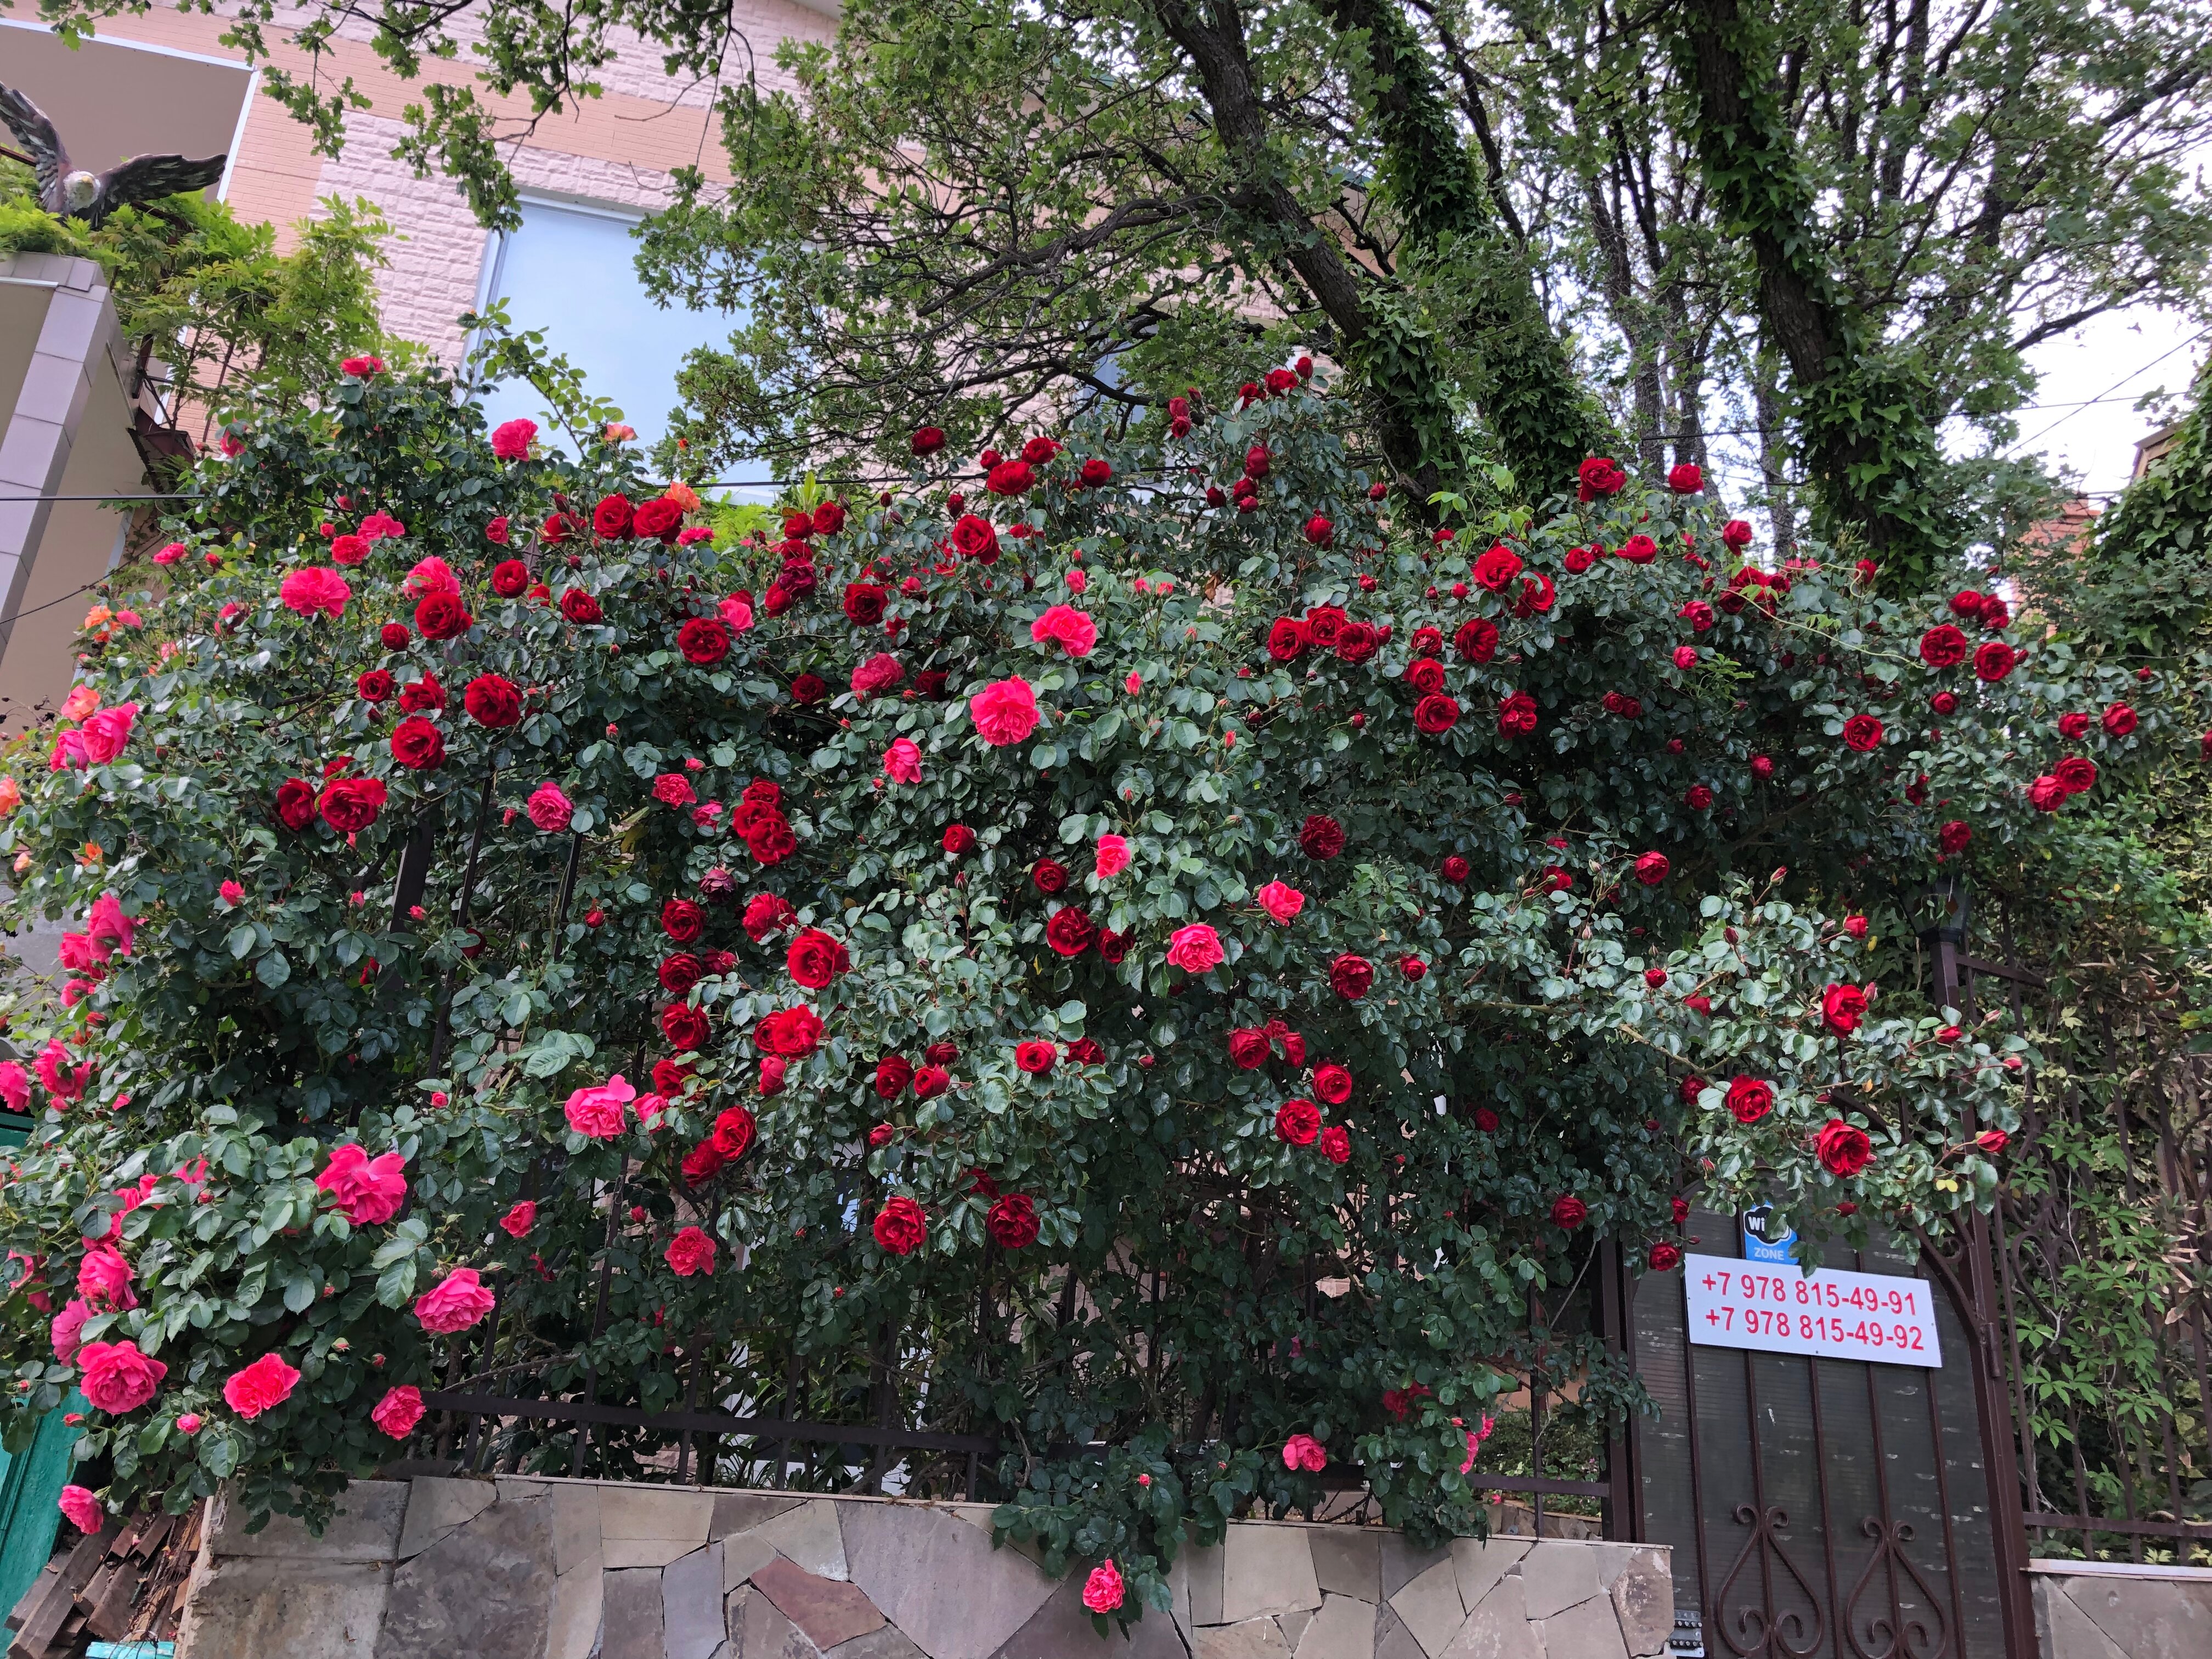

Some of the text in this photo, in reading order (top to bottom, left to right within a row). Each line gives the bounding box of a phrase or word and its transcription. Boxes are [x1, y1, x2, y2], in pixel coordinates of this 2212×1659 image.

[1754, 1247, 1785, 1261] ZONE
[1702, 1271, 1916, 1316] +7 978 815-49-91
[1705, 1306, 1924, 1351] +7 978 815-49-92
